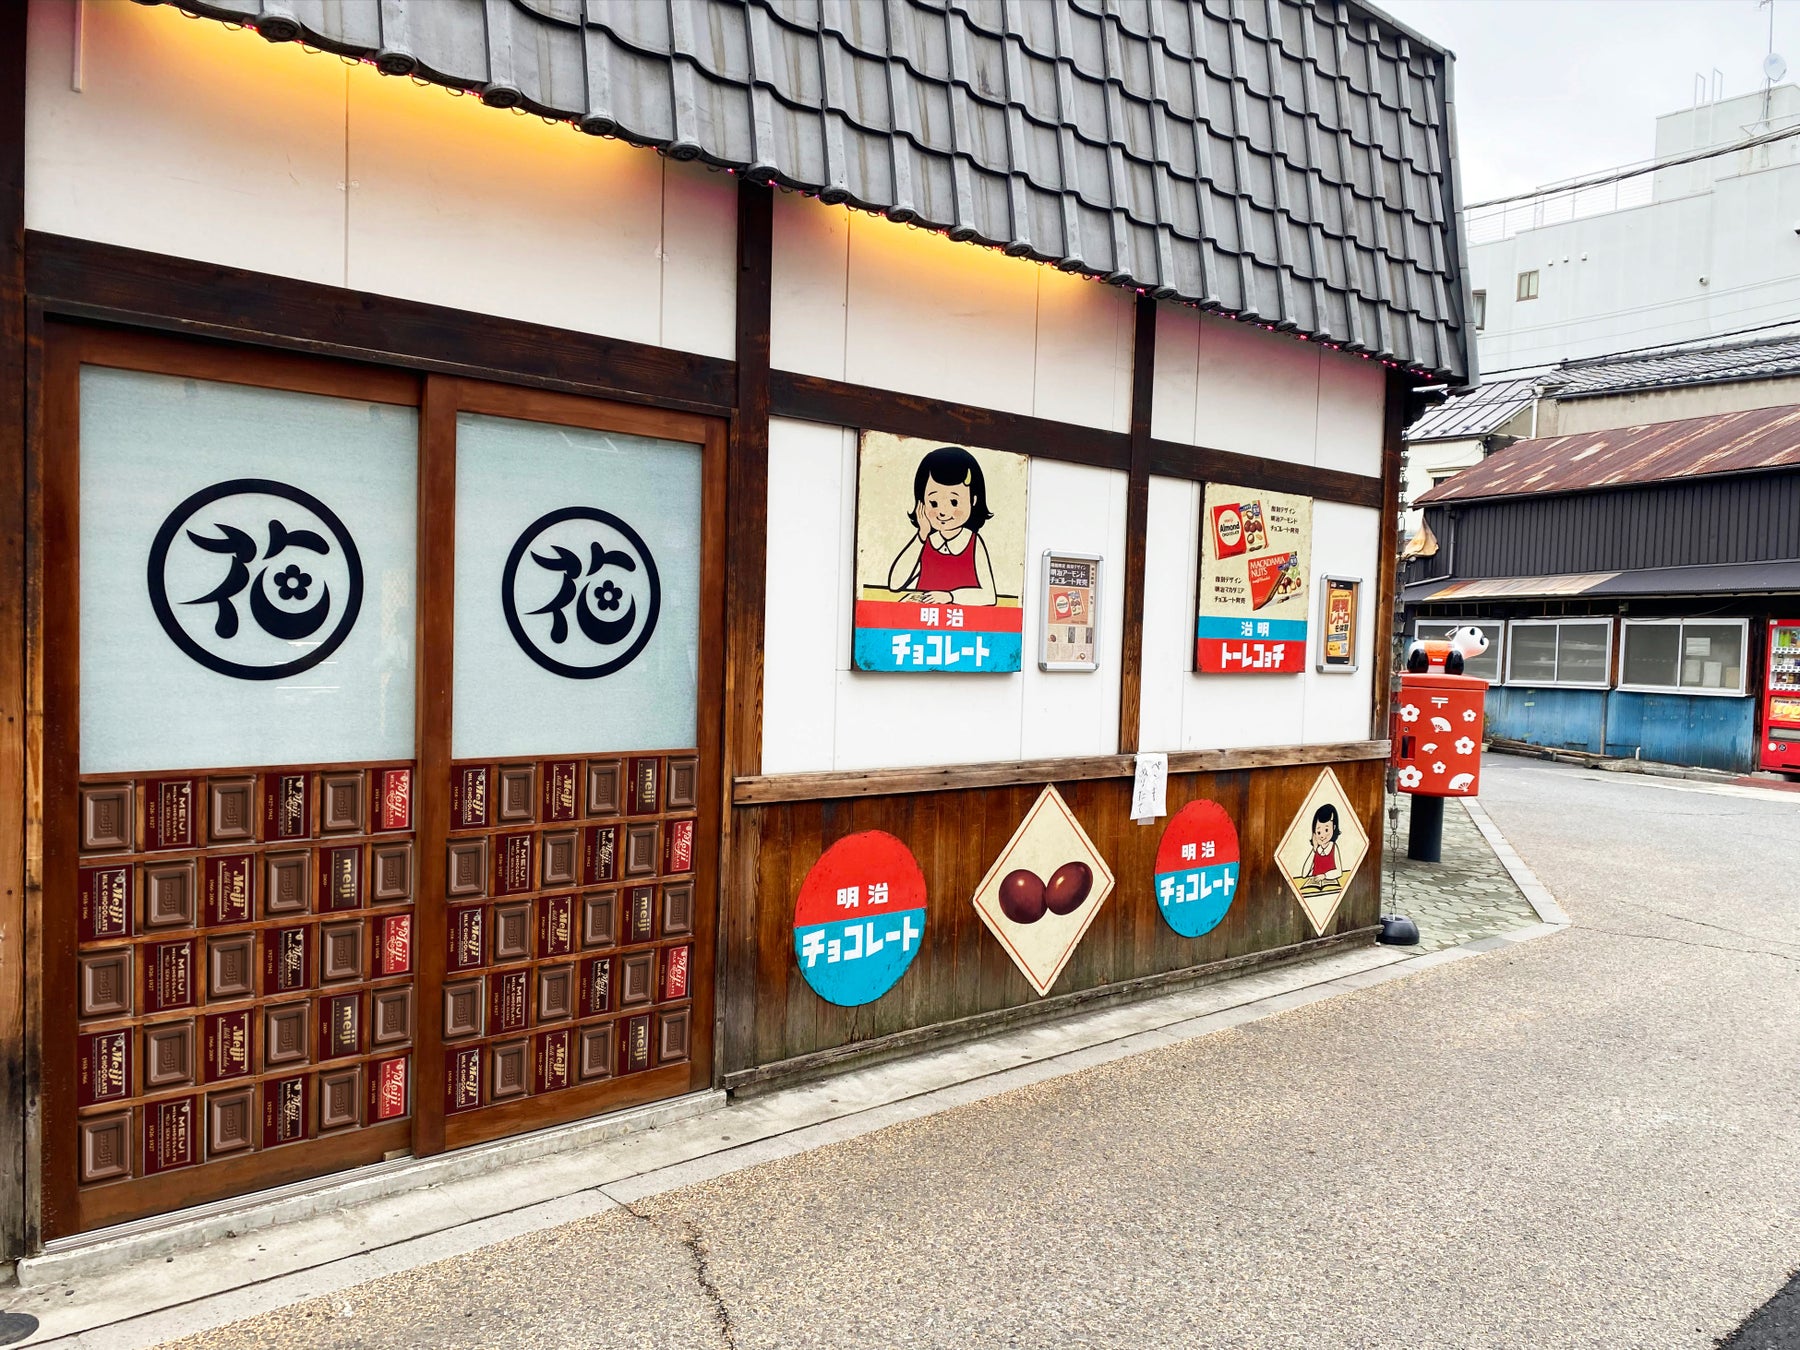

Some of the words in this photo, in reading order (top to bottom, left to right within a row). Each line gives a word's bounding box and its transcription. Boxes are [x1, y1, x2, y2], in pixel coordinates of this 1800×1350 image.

[1220, 522, 1240, 532] Almond
[1250, 556, 1285, 570] MACADAMIA
[1251, 567, 1268, 577] NUTS
[920, 607, 963, 627] 明治
[892, 634, 990, 666] チョコレート
[386, 781, 407, 819] Meiji
[473, 781, 483, 816] Meiji
[561, 774, 571, 806] Meiji
[644, 769, 654, 802] meiji
[285, 790, 302, 818] Meiji
[674, 830, 691, 864] Meiji
[1182, 840, 1215, 861] 明治
[229, 870, 244, 908] Meiji
[340, 858, 354, 897] meiji
[1160, 868, 1234, 906] チョコレート
[109, 882, 122, 924] Meiji
[837, 882, 888, 908] 明治
[556, 908, 567, 941] Meiji
[640, 897, 649, 931] meiji
[386, 925, 408, 965] Meiji
[469, 920, 479, 956] Meiji
[802, 916, 919, 968] チョコレート
[284, 942, 301, 971] Meiji
[669, 955, 686, 990] Meiji
[340, 1005, 354, 1045] meiji
[229, 1025, 243, 1064] Meiji
[553, 1042, 564, 1076] Meiji
[637, 1025, 646, 1060] meiji
[109, 1045, 122, 1088] Meiji
[466, 1061, 476, 1097] Meiji
[381, 1069, 403, 1109] Meiji
[283, 1092, 300, 1122] Meiji
